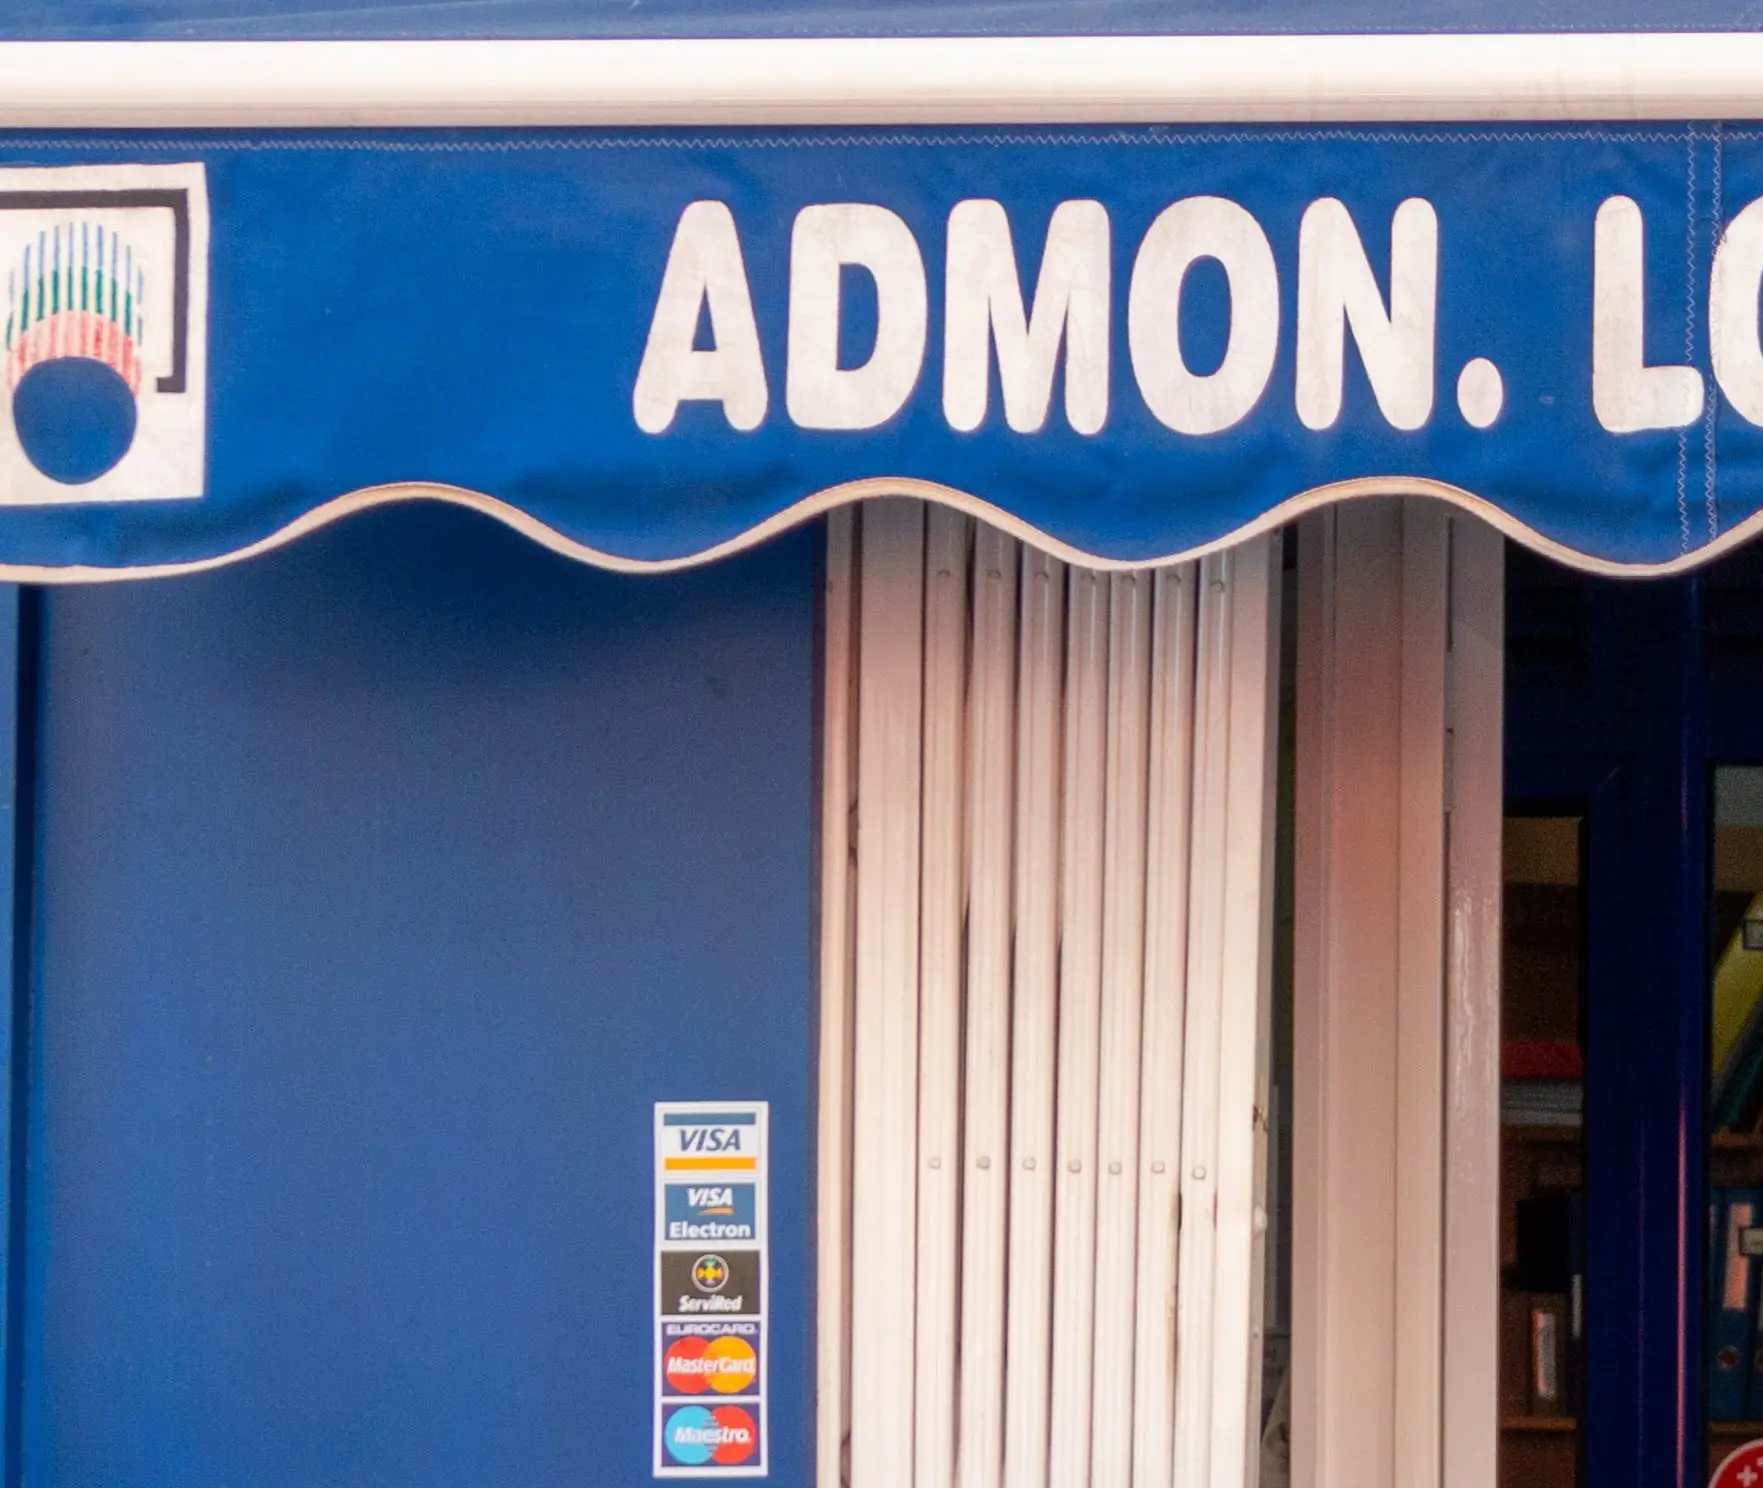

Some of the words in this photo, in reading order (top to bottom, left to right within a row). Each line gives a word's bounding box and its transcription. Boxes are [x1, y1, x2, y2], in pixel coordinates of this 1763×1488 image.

[632, 195, 1504, 436] ADMON.
[678, 1128, 742, 1152] VISA
[687, 1187, 733, 1208] VISA
[669, 1220, 752, 1240] Electron
[678, 1294, 743, 1313] ServiRed
